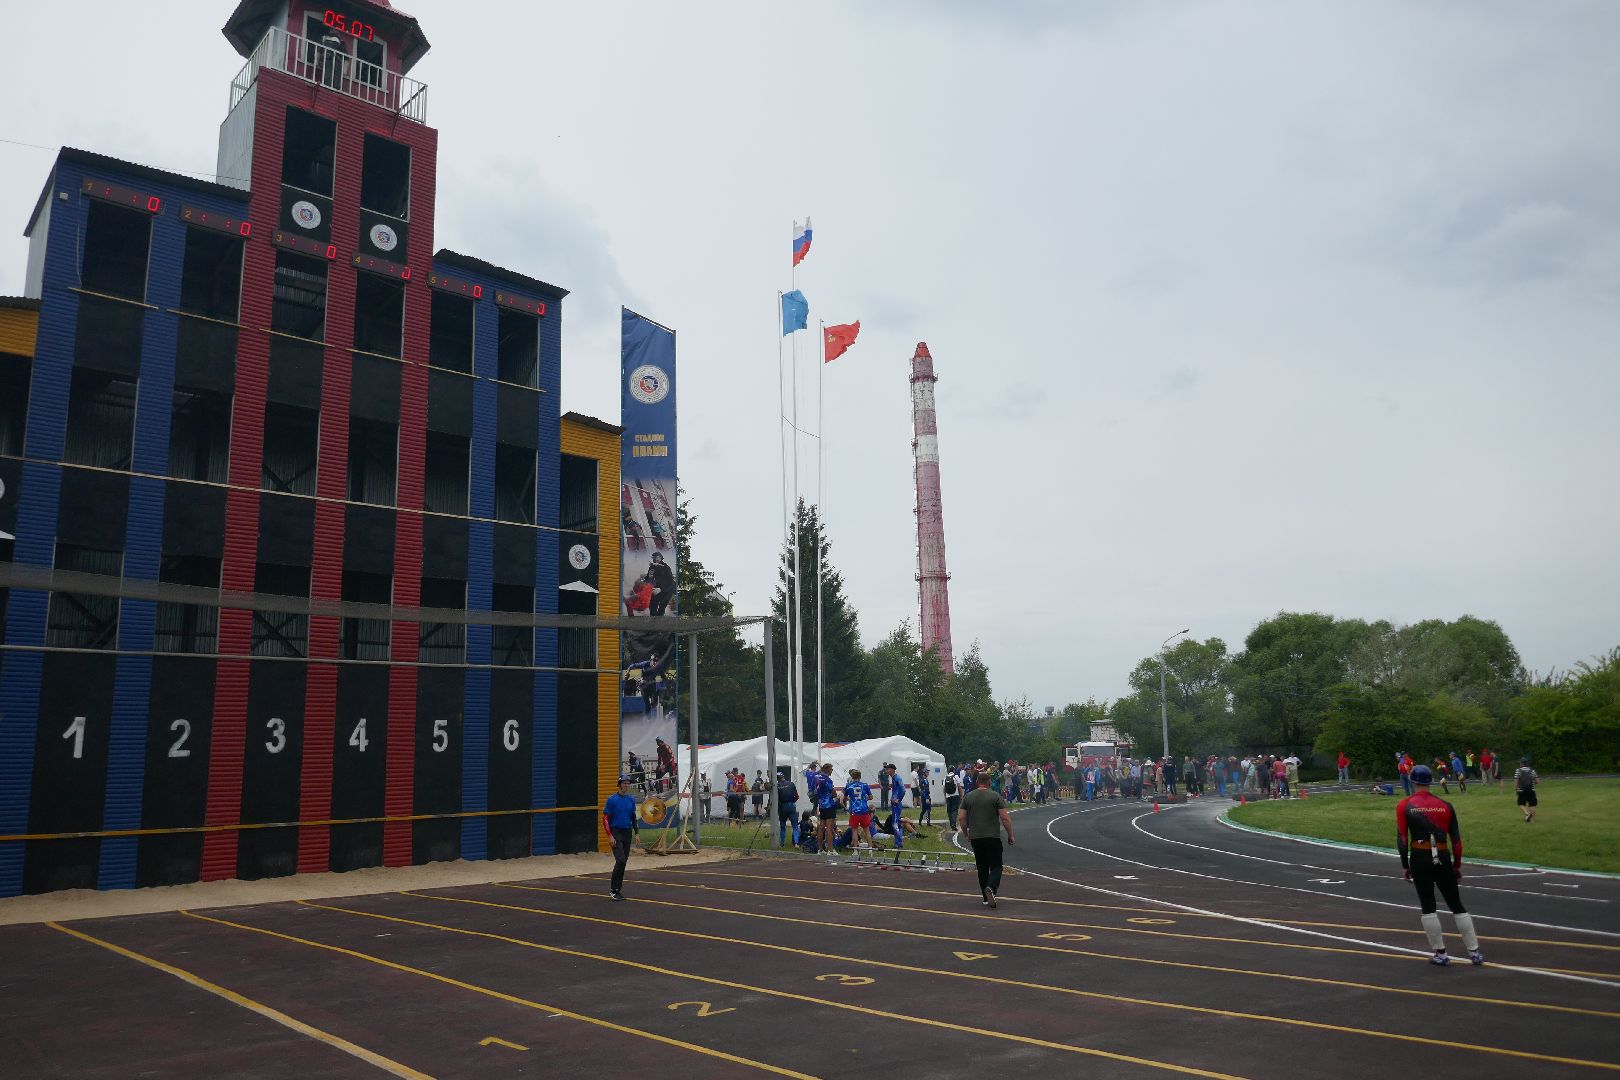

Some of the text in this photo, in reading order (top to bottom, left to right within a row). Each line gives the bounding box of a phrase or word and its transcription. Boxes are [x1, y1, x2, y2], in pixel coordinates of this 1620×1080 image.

[62, 716, 87, 759] 1
[167, 718, 192, 758] 2
[265, 717, 287, 754] 3
[349, 717, 369, 752] 4
[432, 719, 449, 753] 5
[503, 719, 520, 751] 6
[1126, 916, 1177, 925] 6
[1036, 931, 1093, 942] 5
[952, 950, 999, 961] 4
[815, 973, 876, 986] 3
[667, 1001, 737, 1017] 2
[479, 1036, 531, 1051] 1
